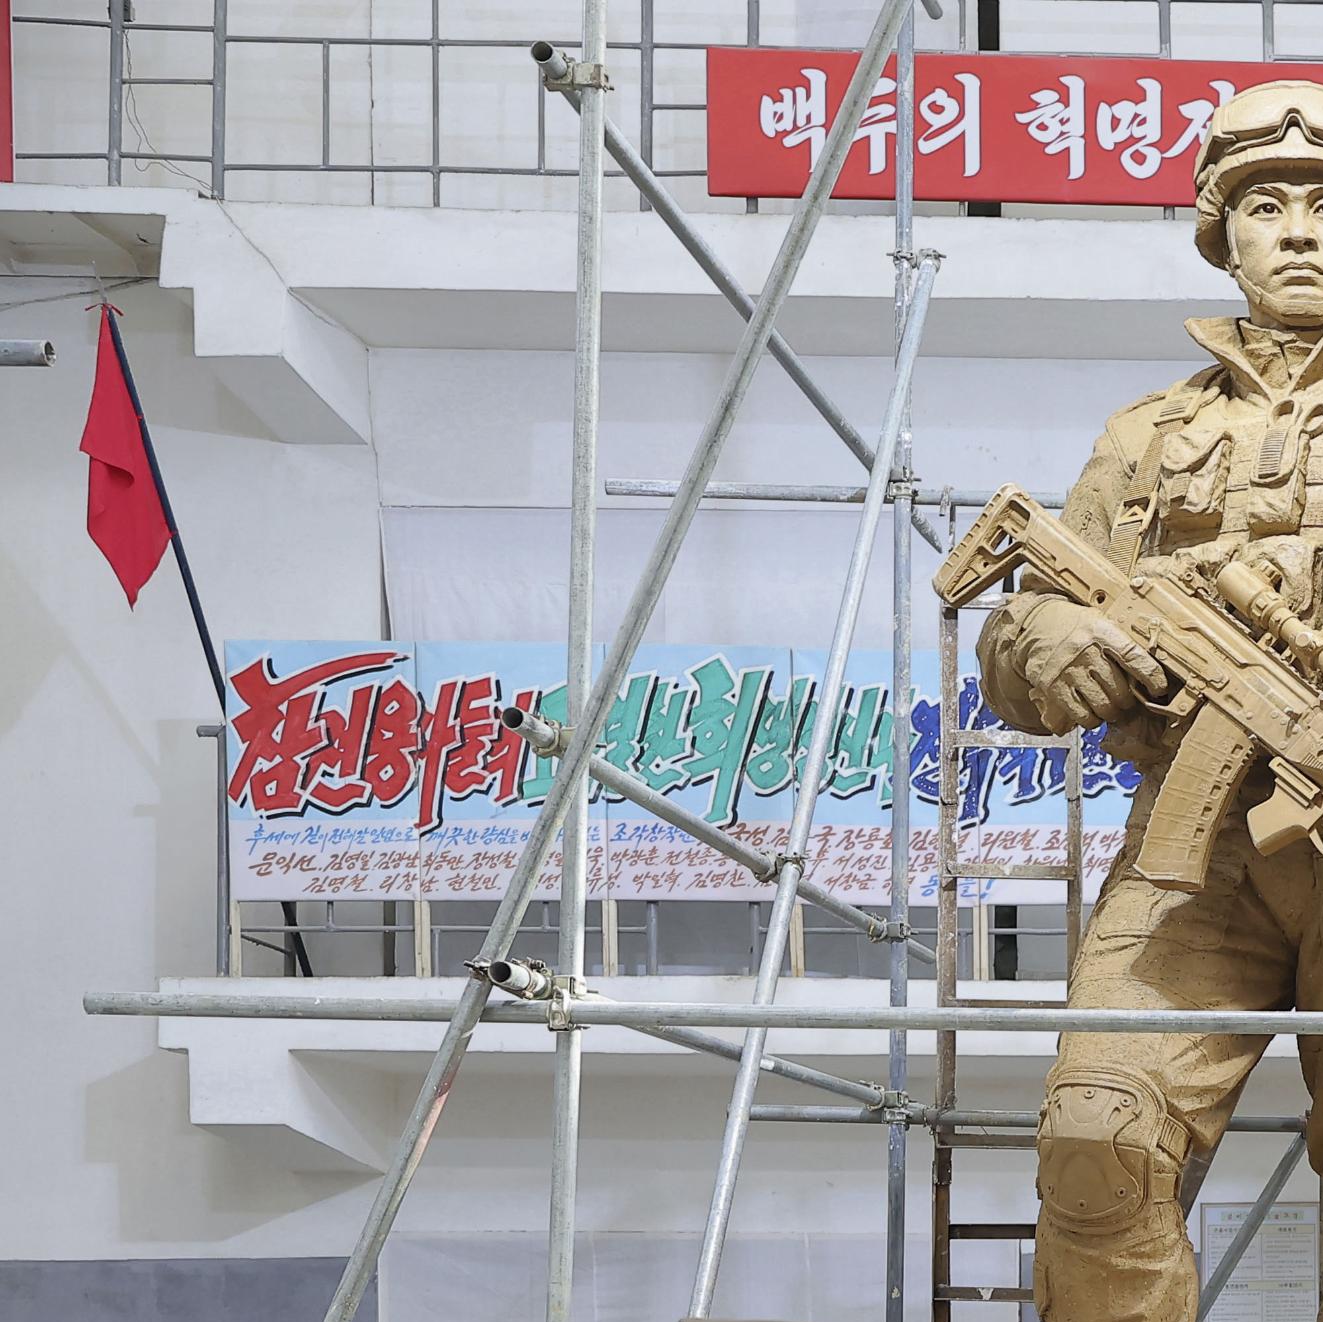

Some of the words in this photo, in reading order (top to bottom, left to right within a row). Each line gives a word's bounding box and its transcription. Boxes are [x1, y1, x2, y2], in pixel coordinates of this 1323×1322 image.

[759, 67, 982, 178] 백두의
[1014, 75, 1236, 180] 혁명
[245, 823, 300, 855] 후세에
